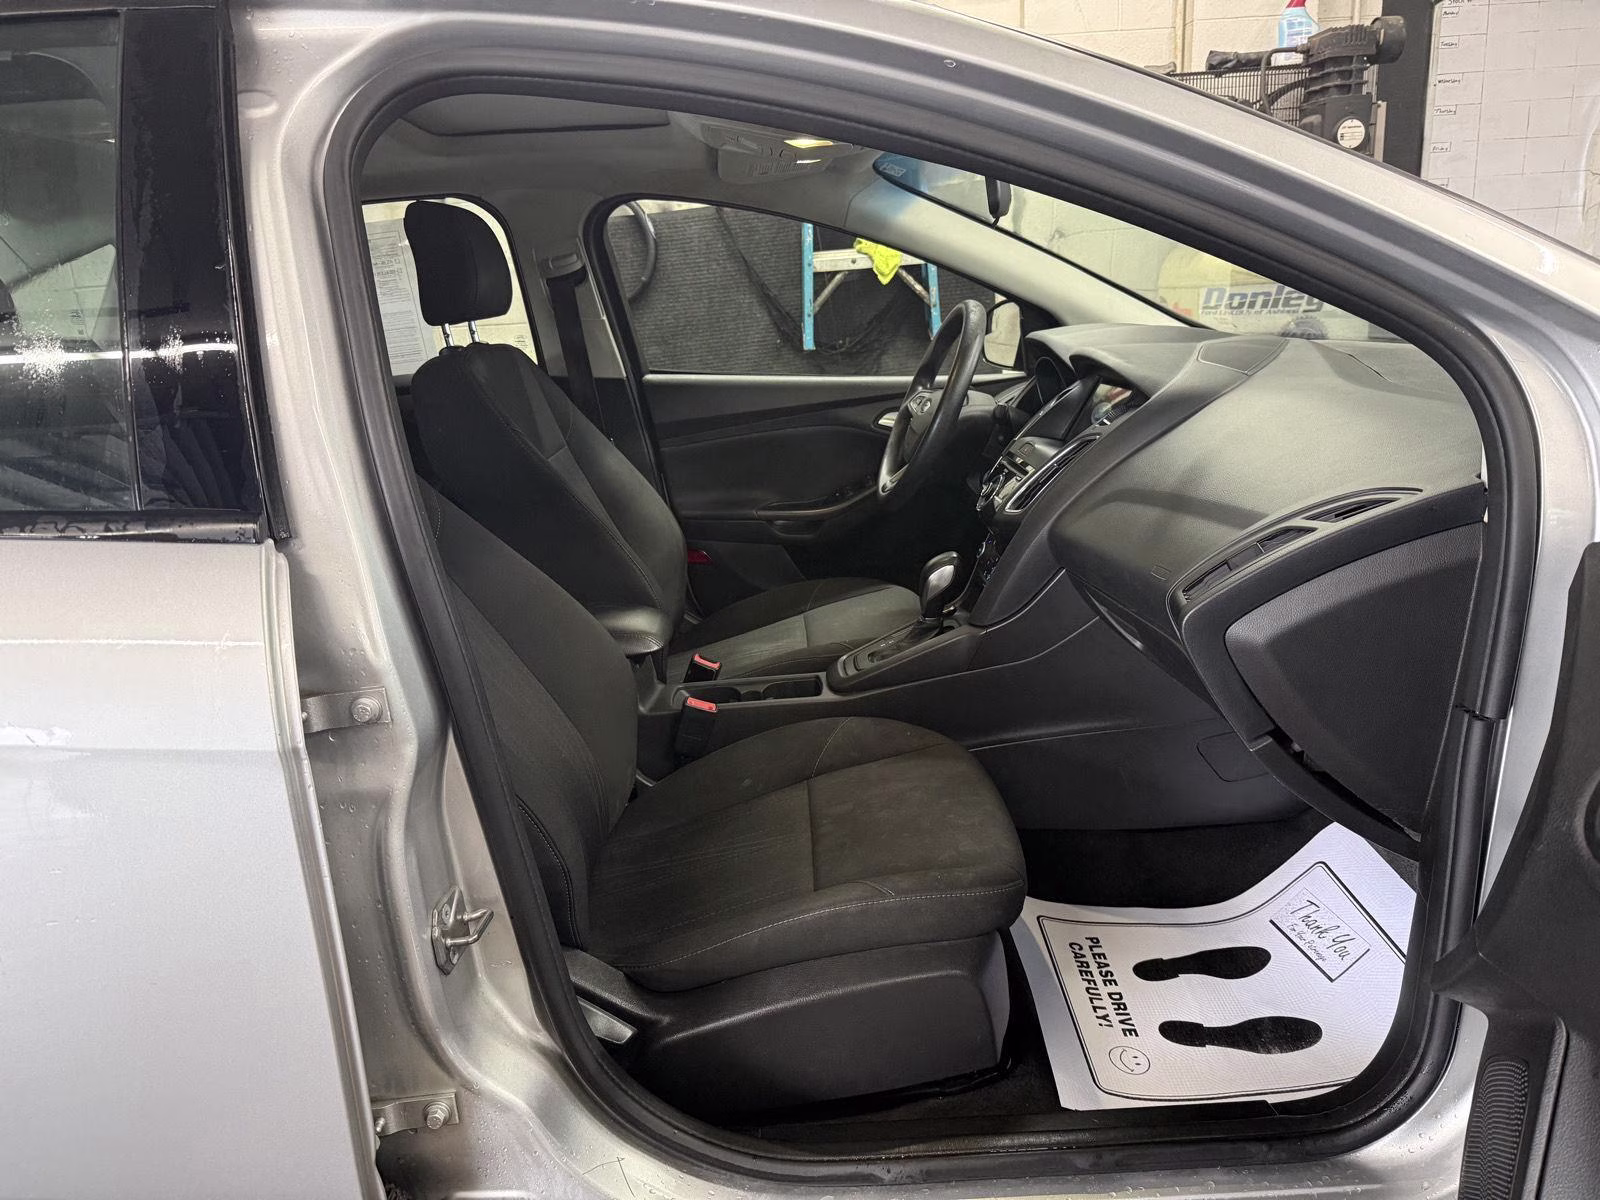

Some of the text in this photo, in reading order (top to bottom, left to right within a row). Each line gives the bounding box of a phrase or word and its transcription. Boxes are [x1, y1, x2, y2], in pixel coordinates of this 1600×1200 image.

[1290, 899, 1357, 961] Thank You
[1069, 942, 1114, 1028] CAREFULLY!
[1085, 937, 1140, 1038] PLEASE DRIVE
